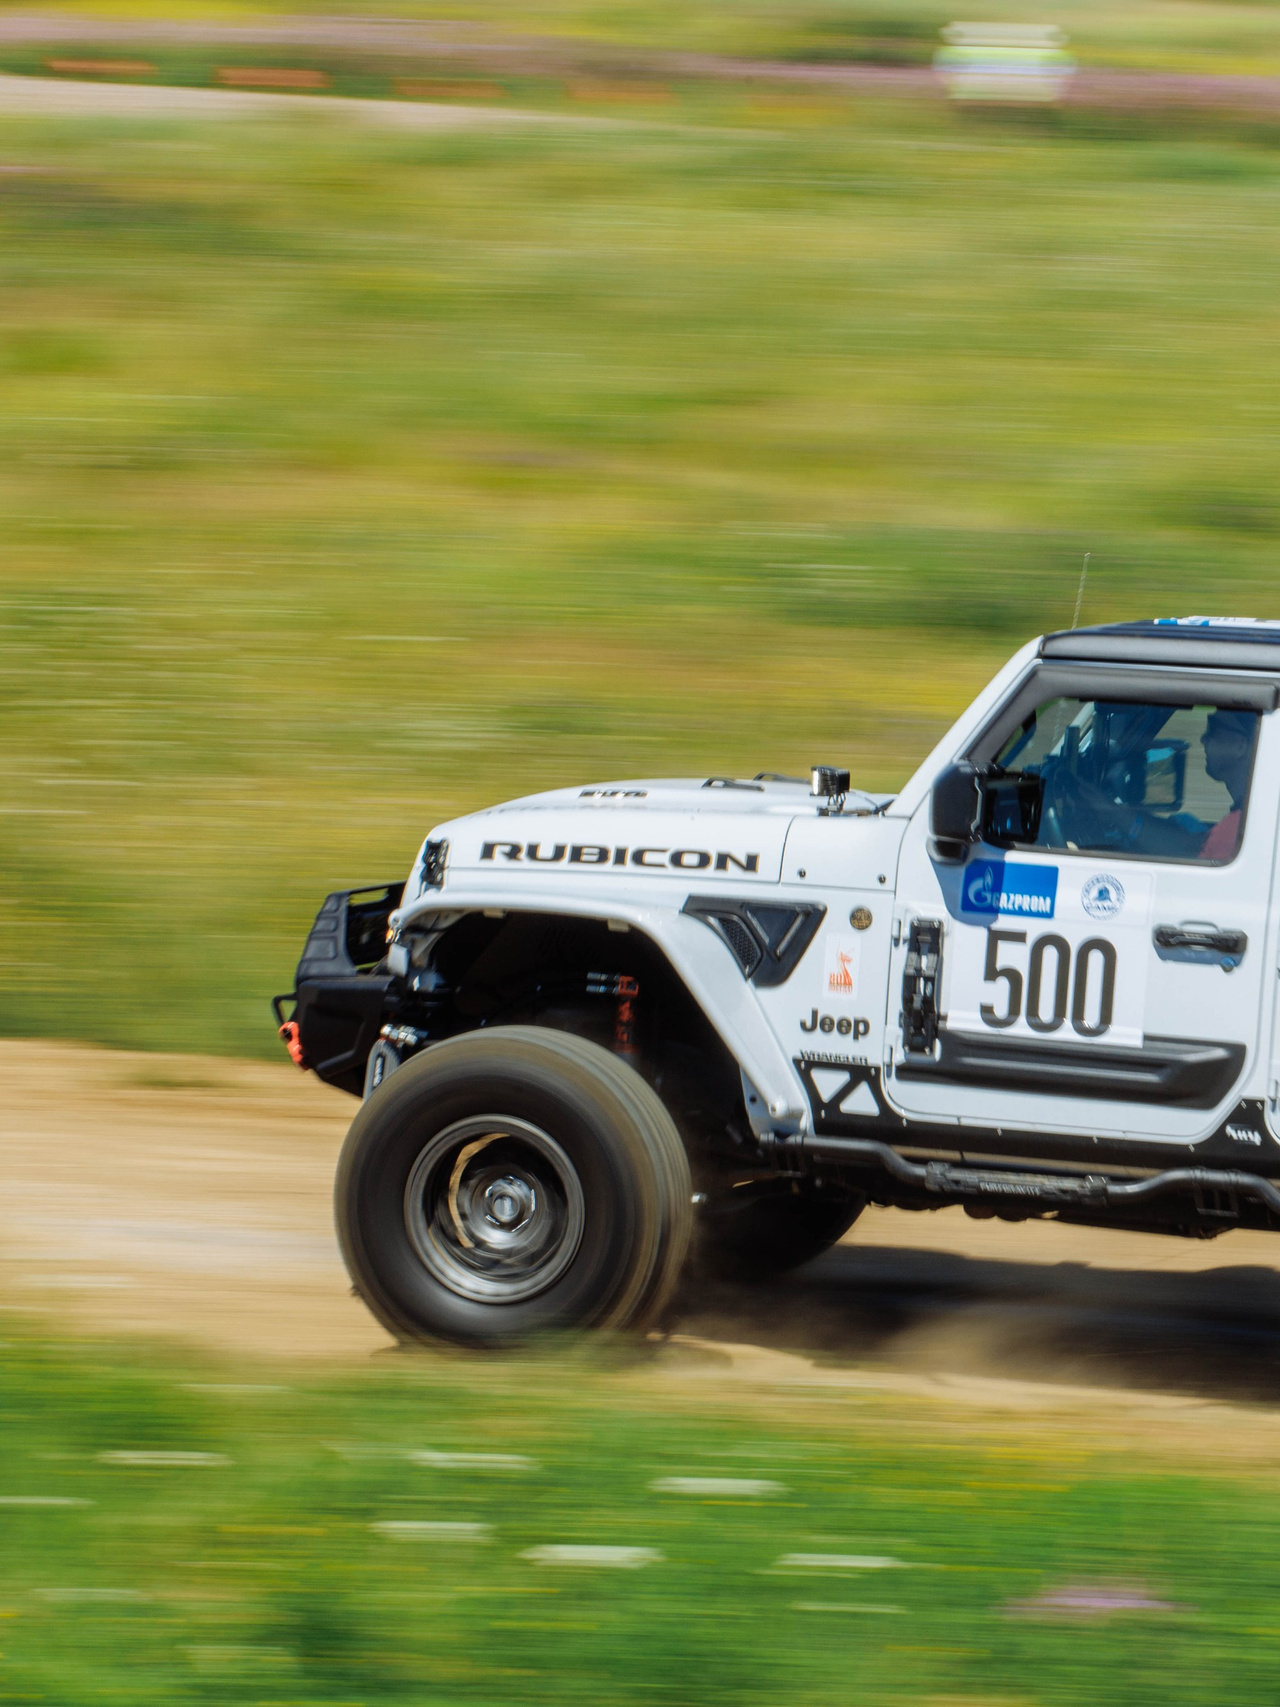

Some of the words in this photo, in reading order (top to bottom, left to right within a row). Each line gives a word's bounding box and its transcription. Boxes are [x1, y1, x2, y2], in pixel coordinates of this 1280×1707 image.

[479, 841, 760, 873] RUBICON
[992, 891, 1051, 914] GAZPROM
[980, 928, 1117, 1038] 500
[800, 1007, 871, 1042] Jeep
[800, 1049, 869, 1067] WRANGLER
